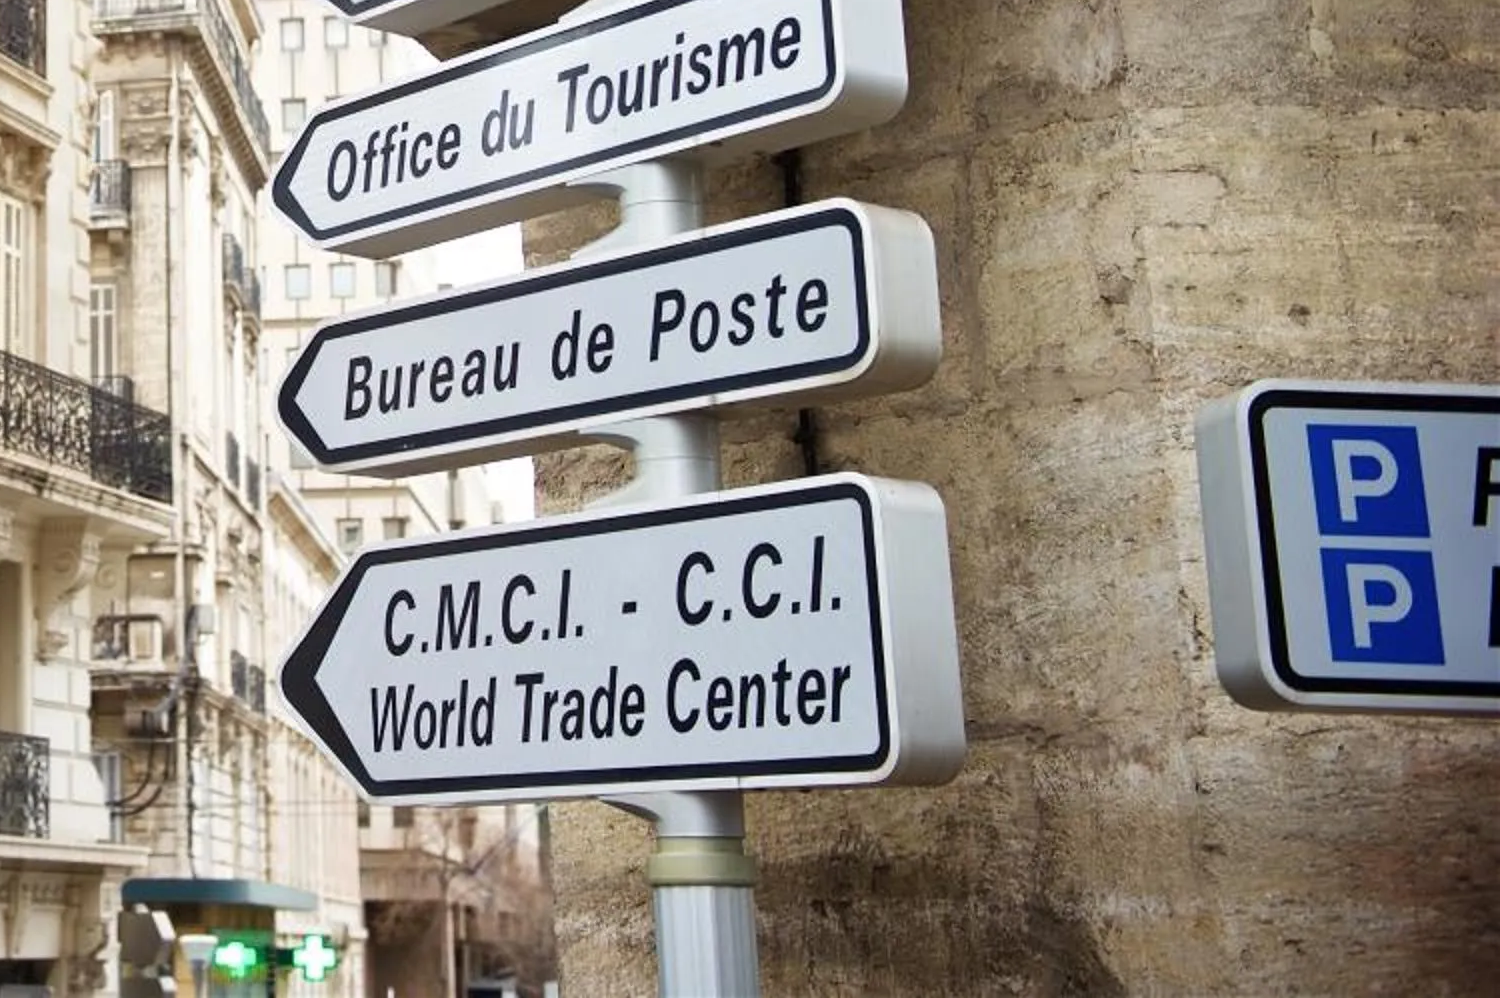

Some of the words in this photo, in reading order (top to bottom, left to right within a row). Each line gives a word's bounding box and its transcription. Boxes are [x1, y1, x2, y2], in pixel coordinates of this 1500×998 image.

[327, 120, 461, 202] Office
[481, 89, 535, 157] du
[557, 15, 802, 134] Tourisme
[343, 340, 519, 421] Bureau
[551, 310, 615, 381] de
[648, 273, 830, 362] Poste
[383, 569, 585, 657] C.M.C.I.
[675, 535, 842, 627] C.C.I.
[370, 676, 496, 753] World
[515, 665, 645, 743] Trade
[665, 657, 851, 733] Center
